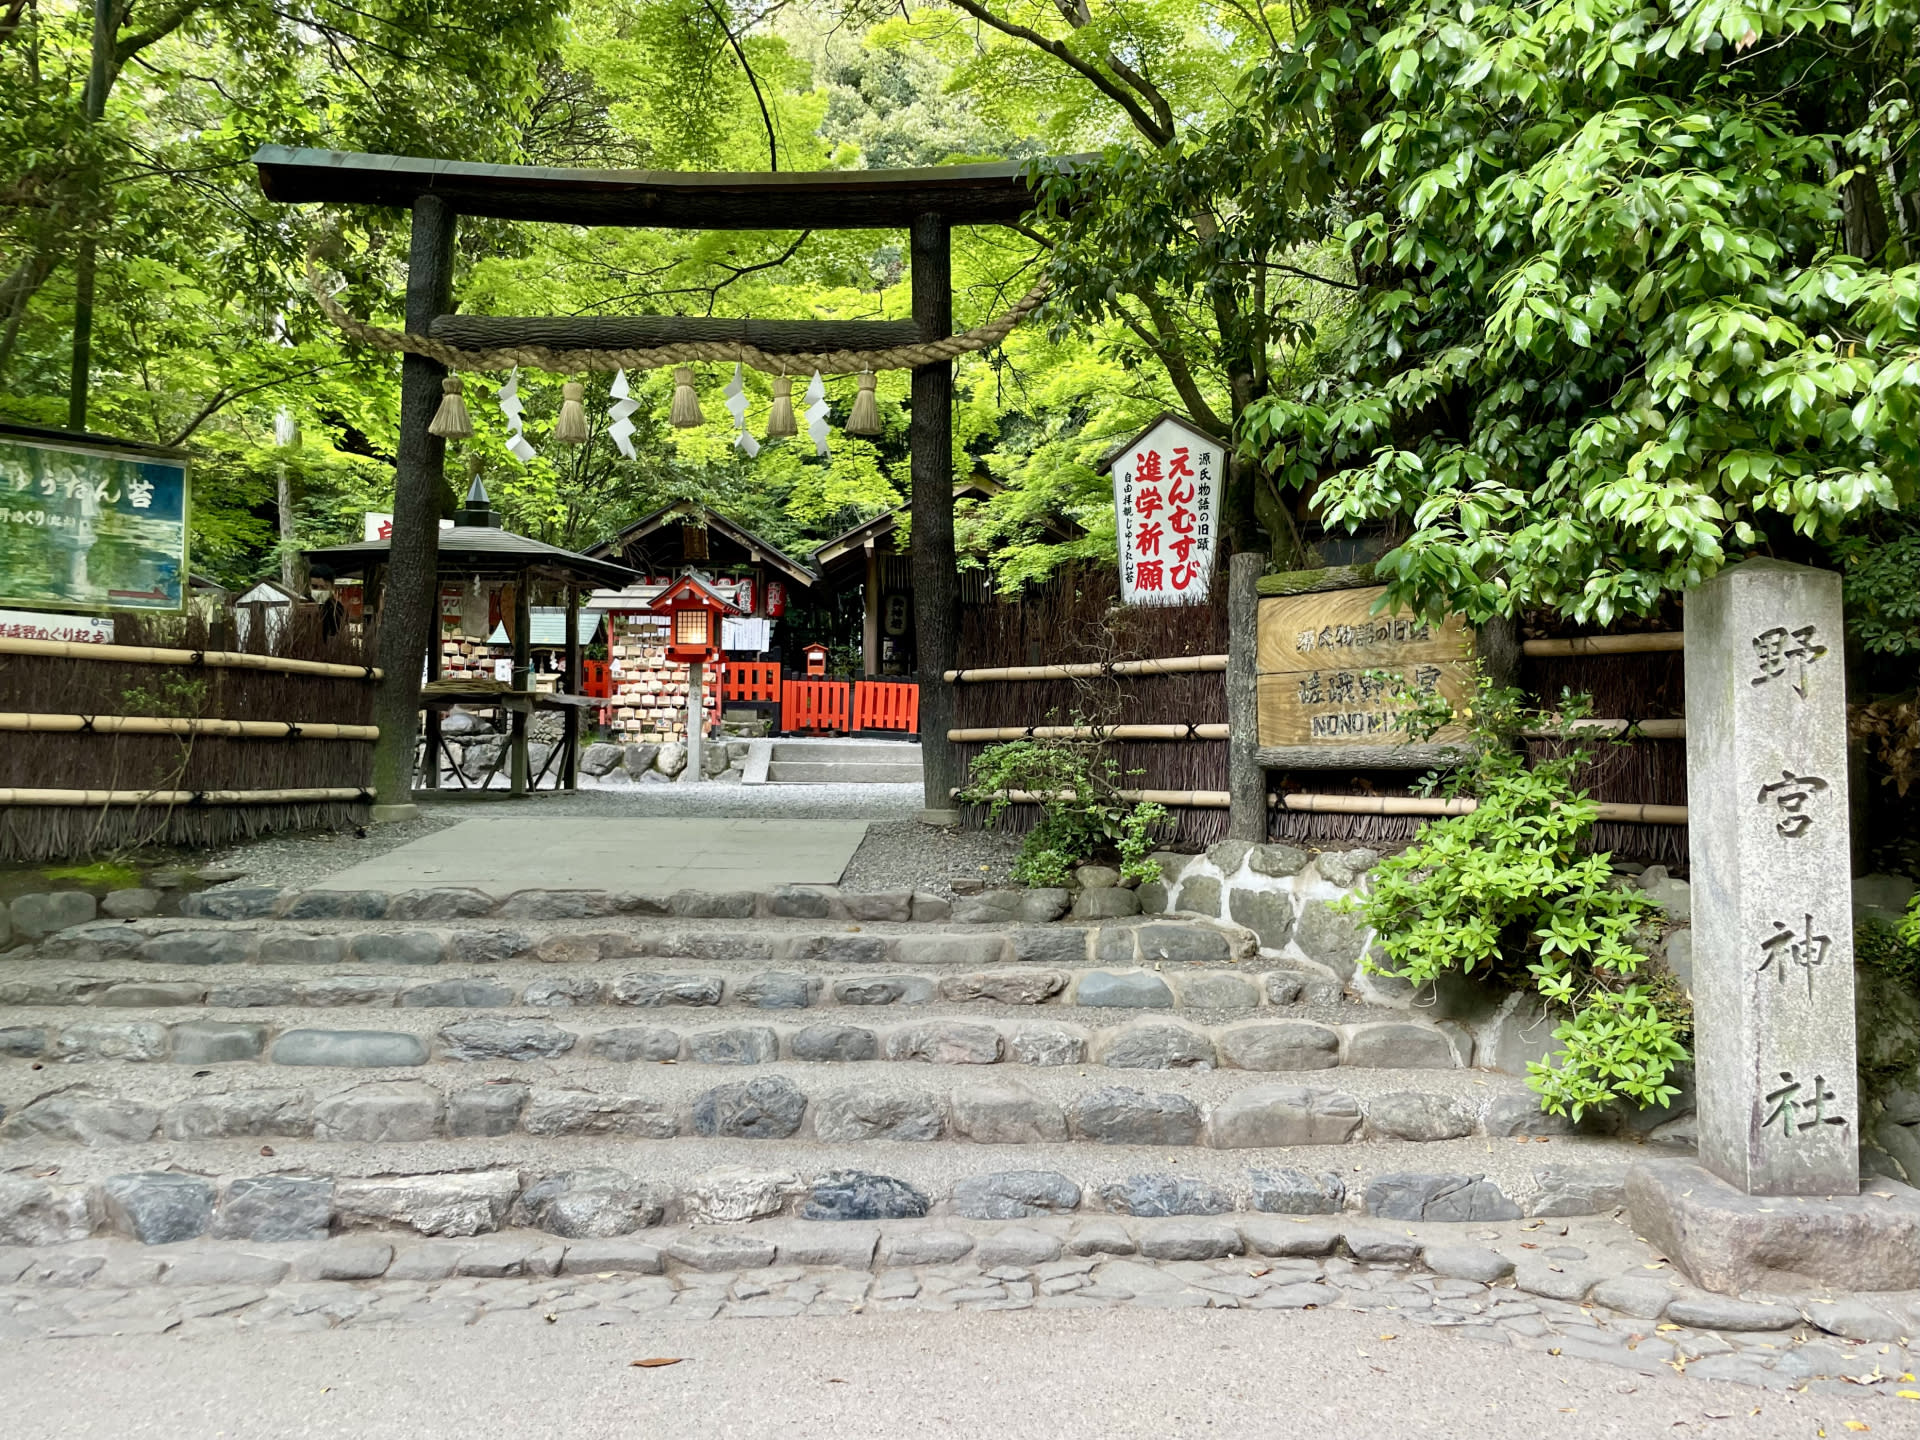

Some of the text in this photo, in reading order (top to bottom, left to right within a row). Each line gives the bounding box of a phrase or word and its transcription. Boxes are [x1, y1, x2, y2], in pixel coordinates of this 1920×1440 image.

[1122, 472, 1134, 584] 自由拝観じゅうたん苔
[1135, 450, 1165, 592] 進学祈願
[1168, 447, 1200, 591] えんむすび
[1196, 452, 1212, 551] 源氏物語の旧蹟
[1751, 624, 1847, 1138] 野宮神社
